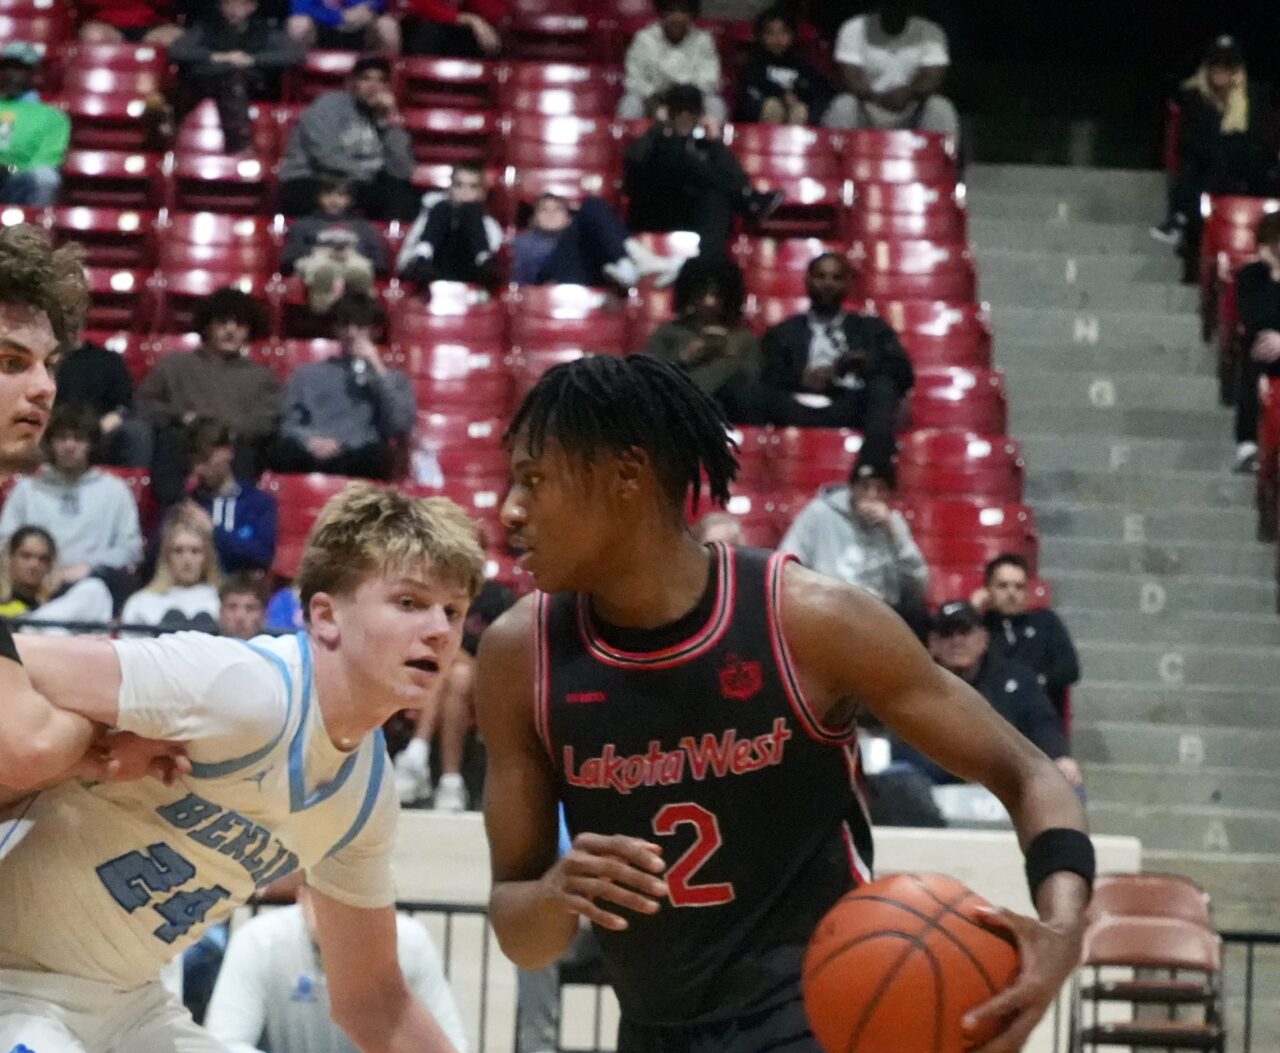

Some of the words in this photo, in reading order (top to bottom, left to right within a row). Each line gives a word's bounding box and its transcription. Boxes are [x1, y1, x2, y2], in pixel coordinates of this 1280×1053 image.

[1074, 317, 1099, 343] H
[1140, 582, 1165, 614] D
[1158, 653, 1184, 683] C
[563, 740, 685, 794] Lakota
[679, 716, 793, 781] West
[651, 801, 736, 908] 2
[95, 841, 232, 945] 24
